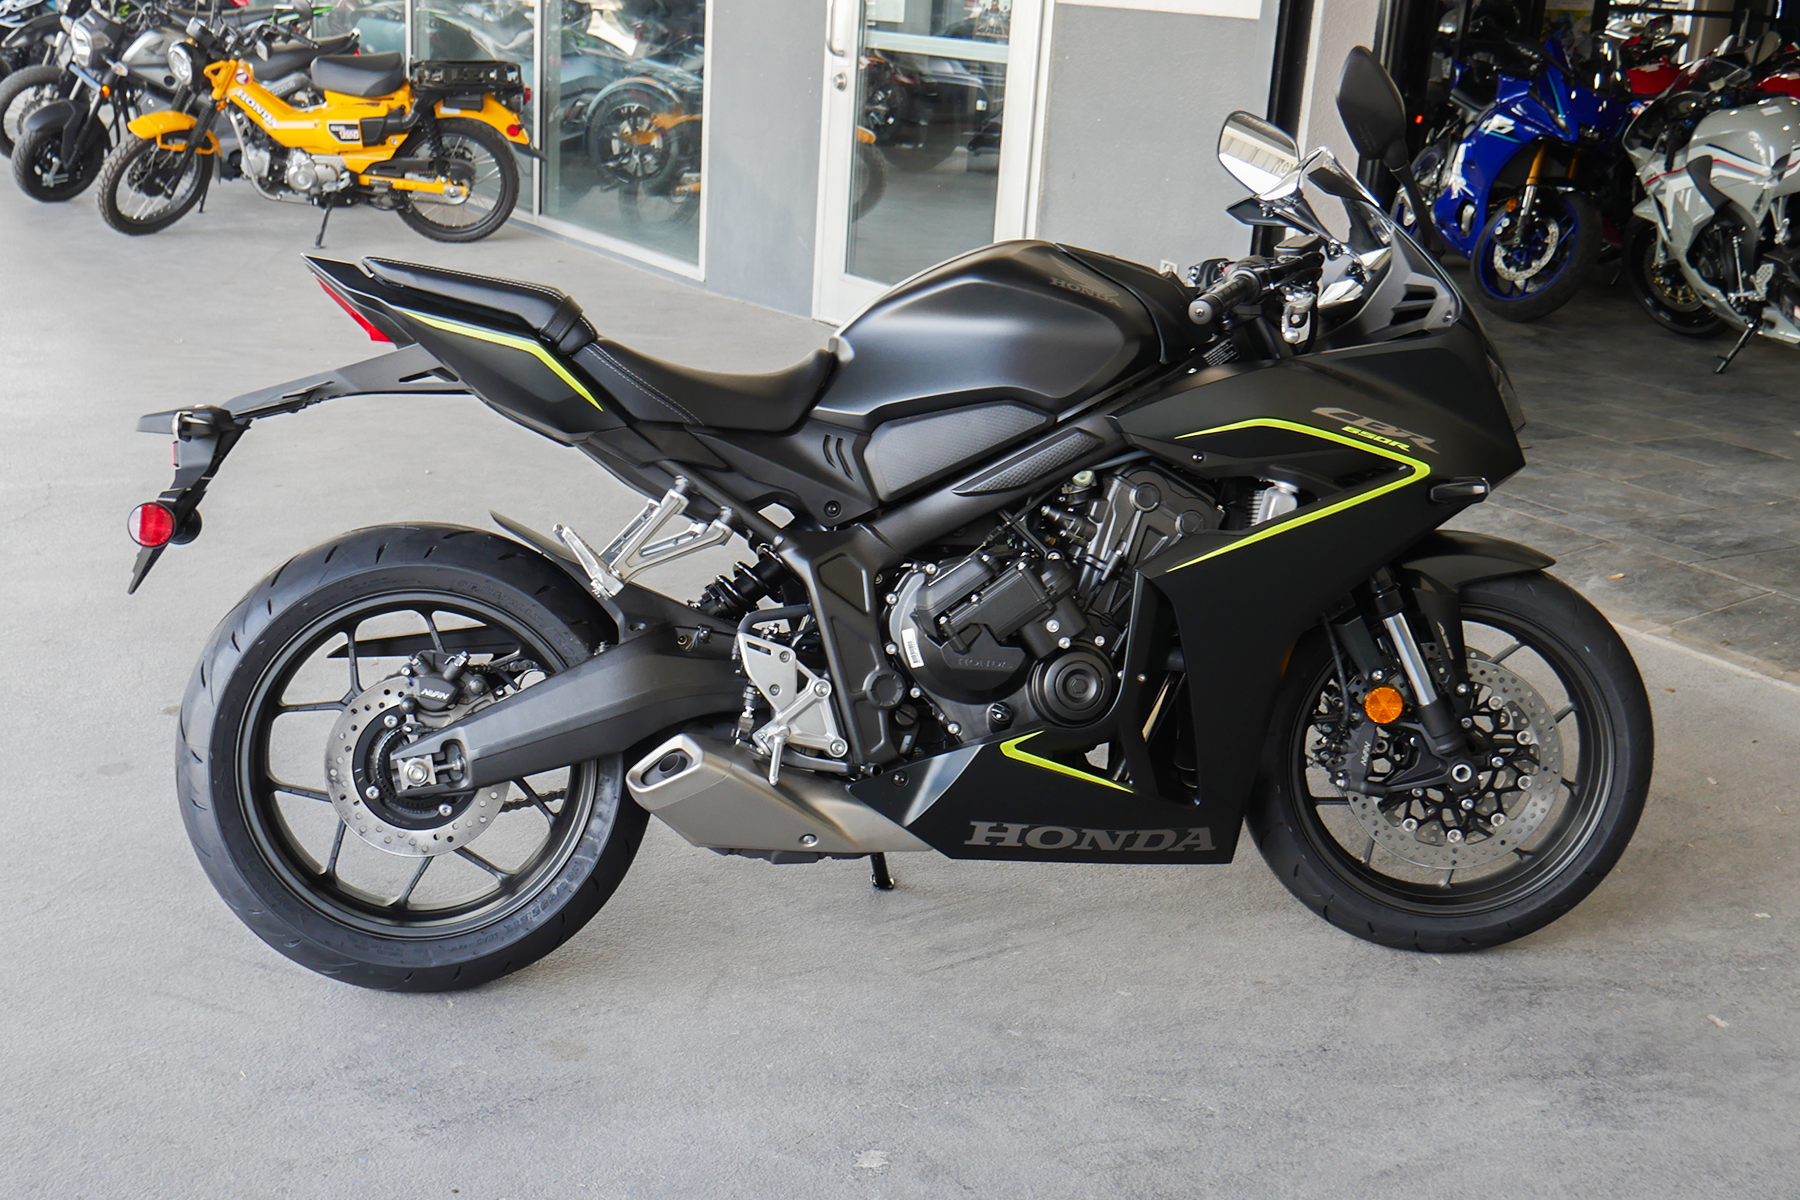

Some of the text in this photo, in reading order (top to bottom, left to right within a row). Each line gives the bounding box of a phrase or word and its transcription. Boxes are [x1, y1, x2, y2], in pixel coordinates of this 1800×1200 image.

[235, 88, 278, 131] HONDA
[1048, 277, 1123, 309] HONDA
[1311, 407, 1440, 454] CBR
[1341, 425, 1410, 452] 650R
[963, 820, 1217, 852] HONDA
